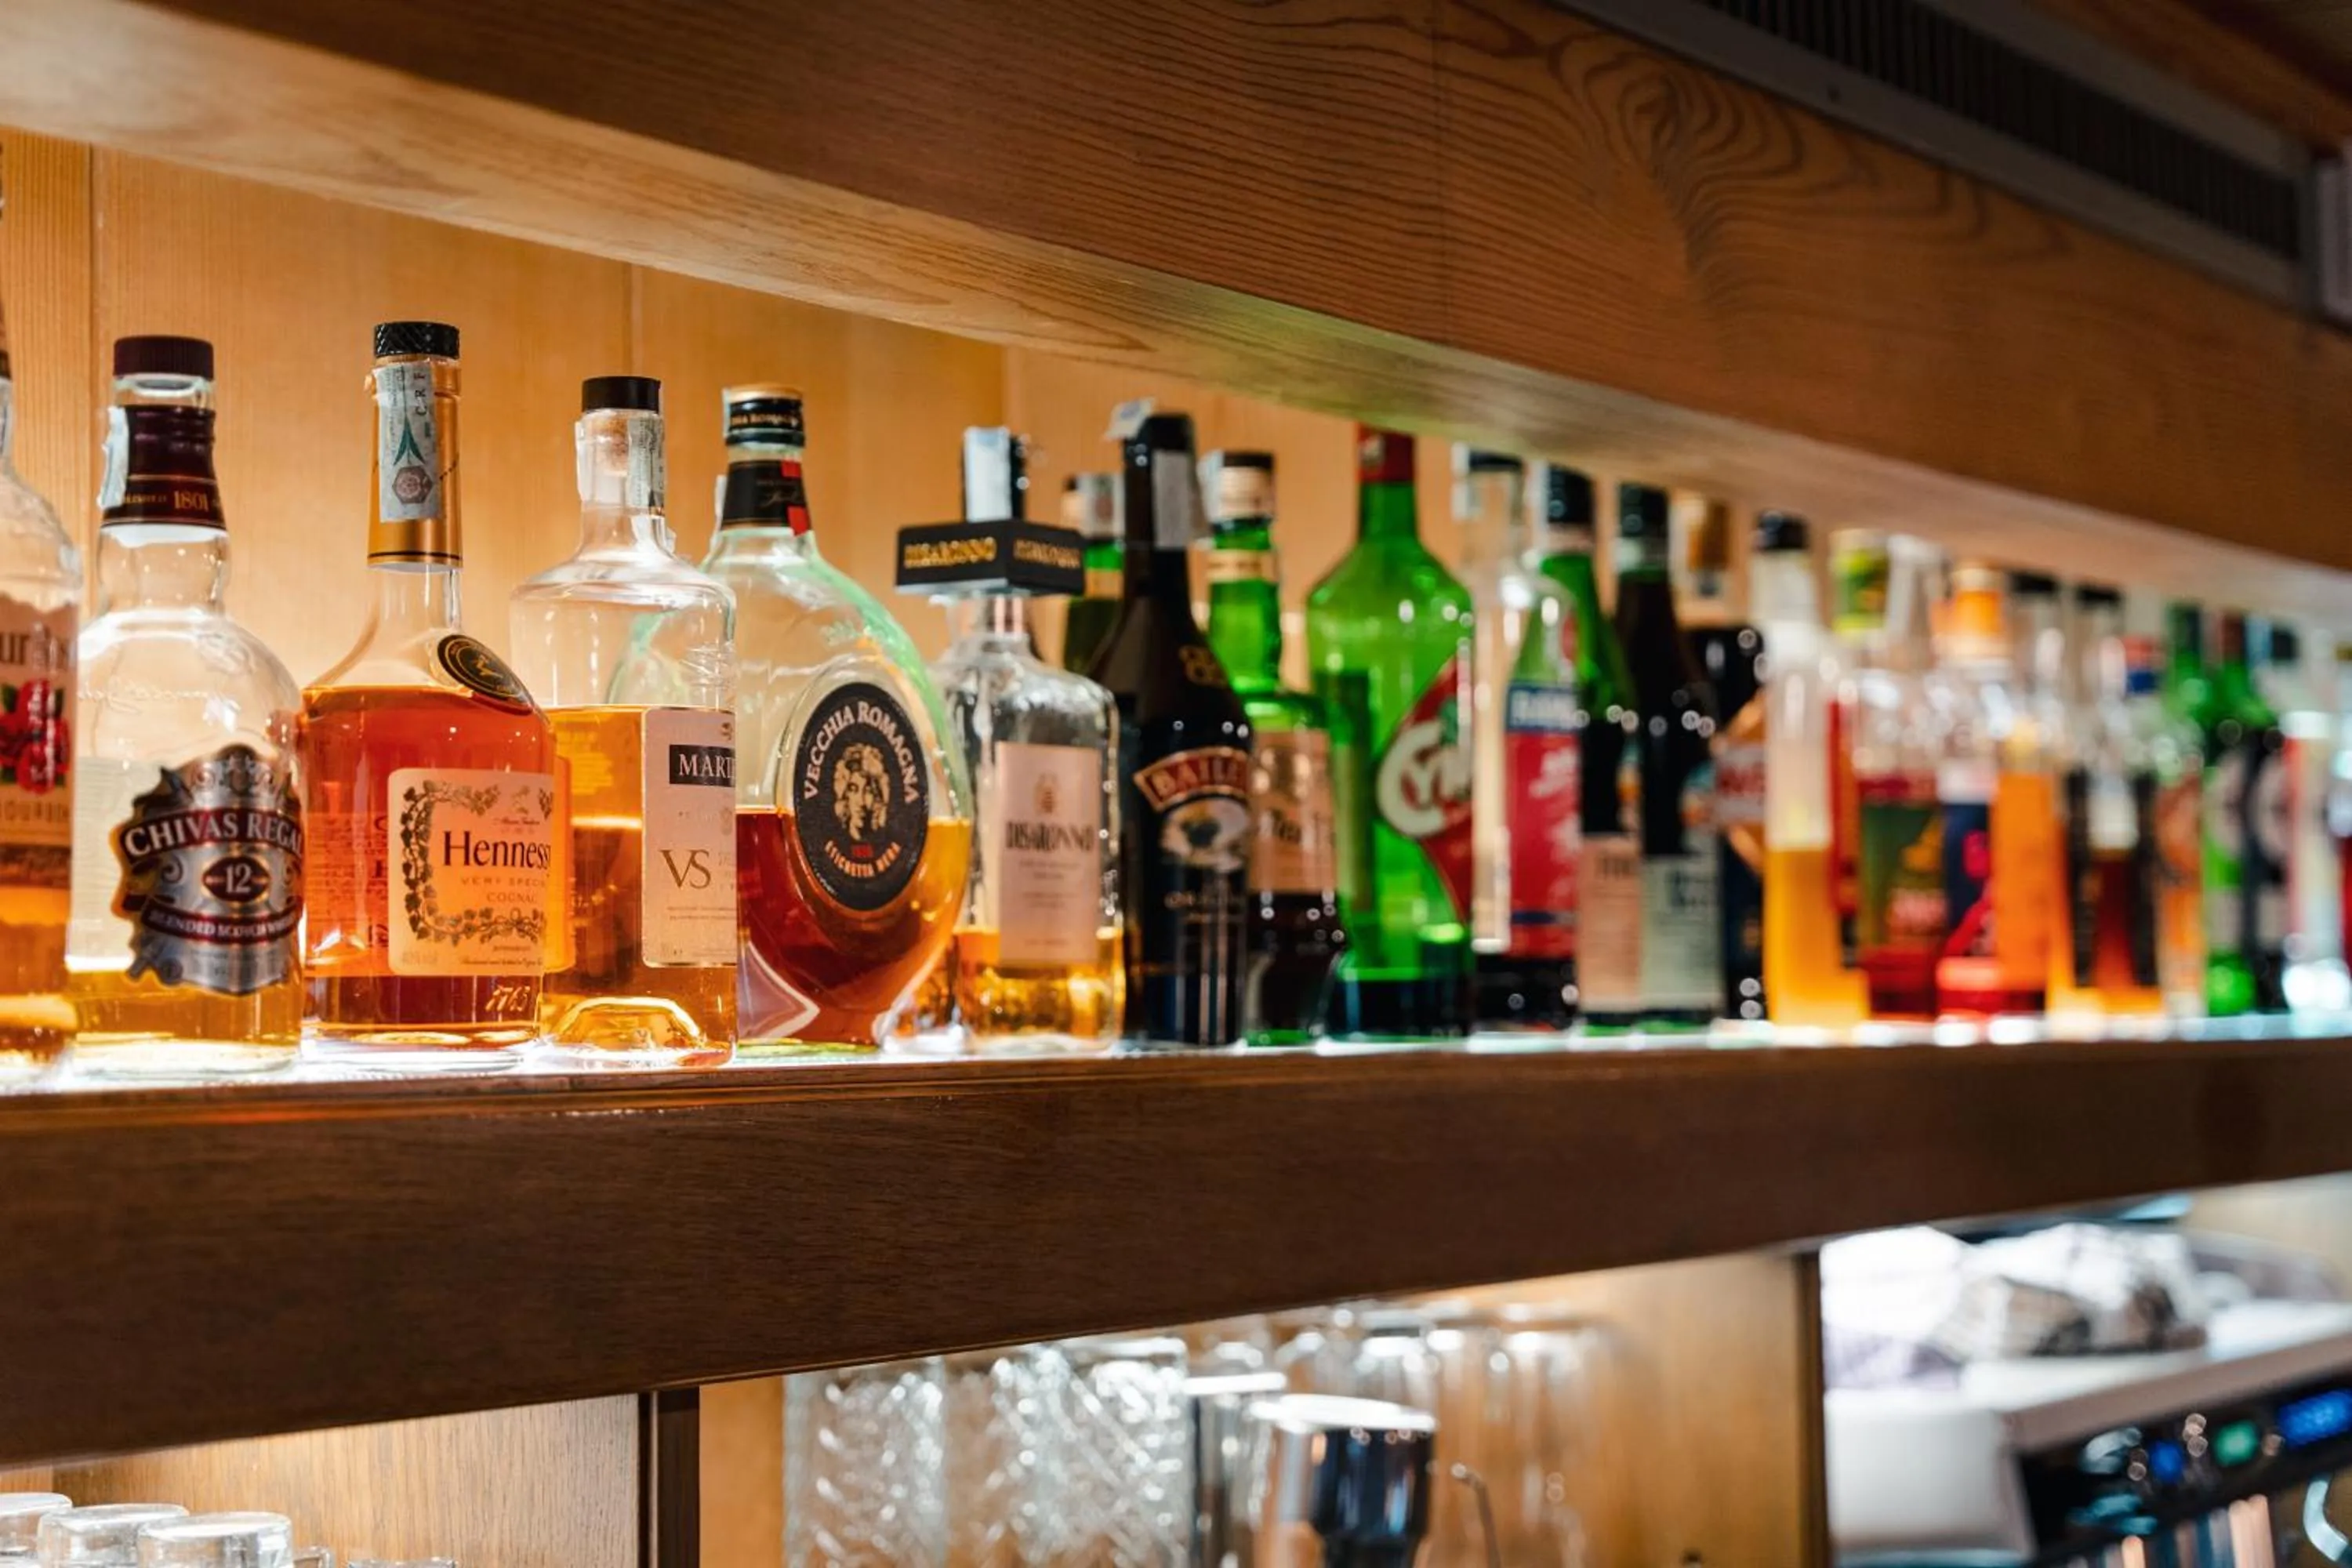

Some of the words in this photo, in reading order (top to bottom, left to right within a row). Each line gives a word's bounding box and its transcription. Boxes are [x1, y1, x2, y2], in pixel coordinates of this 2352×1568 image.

[173, 489, 209, 513] 1801
[804, 705, 855, 800] VECCHIA
[857, 701, 920, 804] ROMAGNA
[125, 812, 239, 857] CHIVAS
[225, 863, 252, 894] 12
[658, 849, 712, 890] VS
